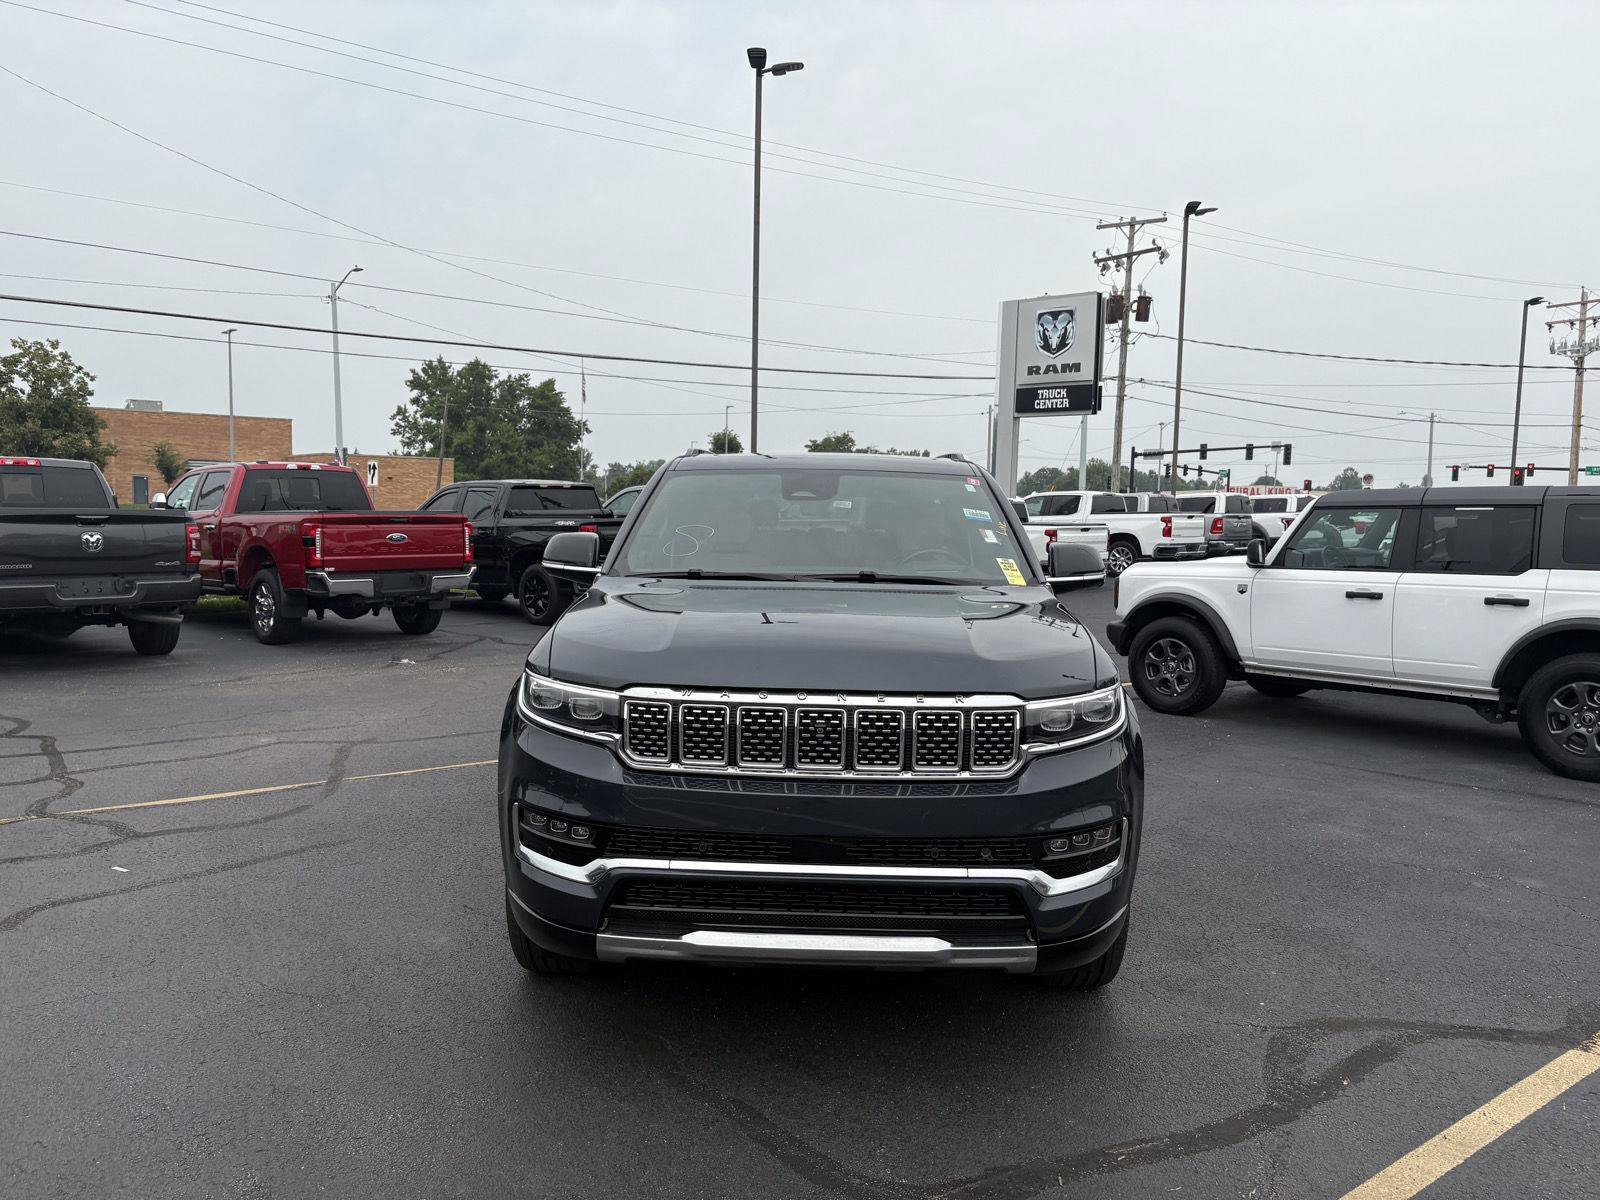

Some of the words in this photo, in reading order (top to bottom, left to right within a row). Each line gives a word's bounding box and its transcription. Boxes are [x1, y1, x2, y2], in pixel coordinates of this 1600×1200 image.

[1026, 362, 1081, 376] RAM
[1037, 388, 1067, 399] TRUCK
[1034, 399, 1069, 409] CENTER
[1229, 487, 1261, 496] RURAL
[1267, 487, 1292, 496] KING
[680, 689, 965, 704] WAGONEER
